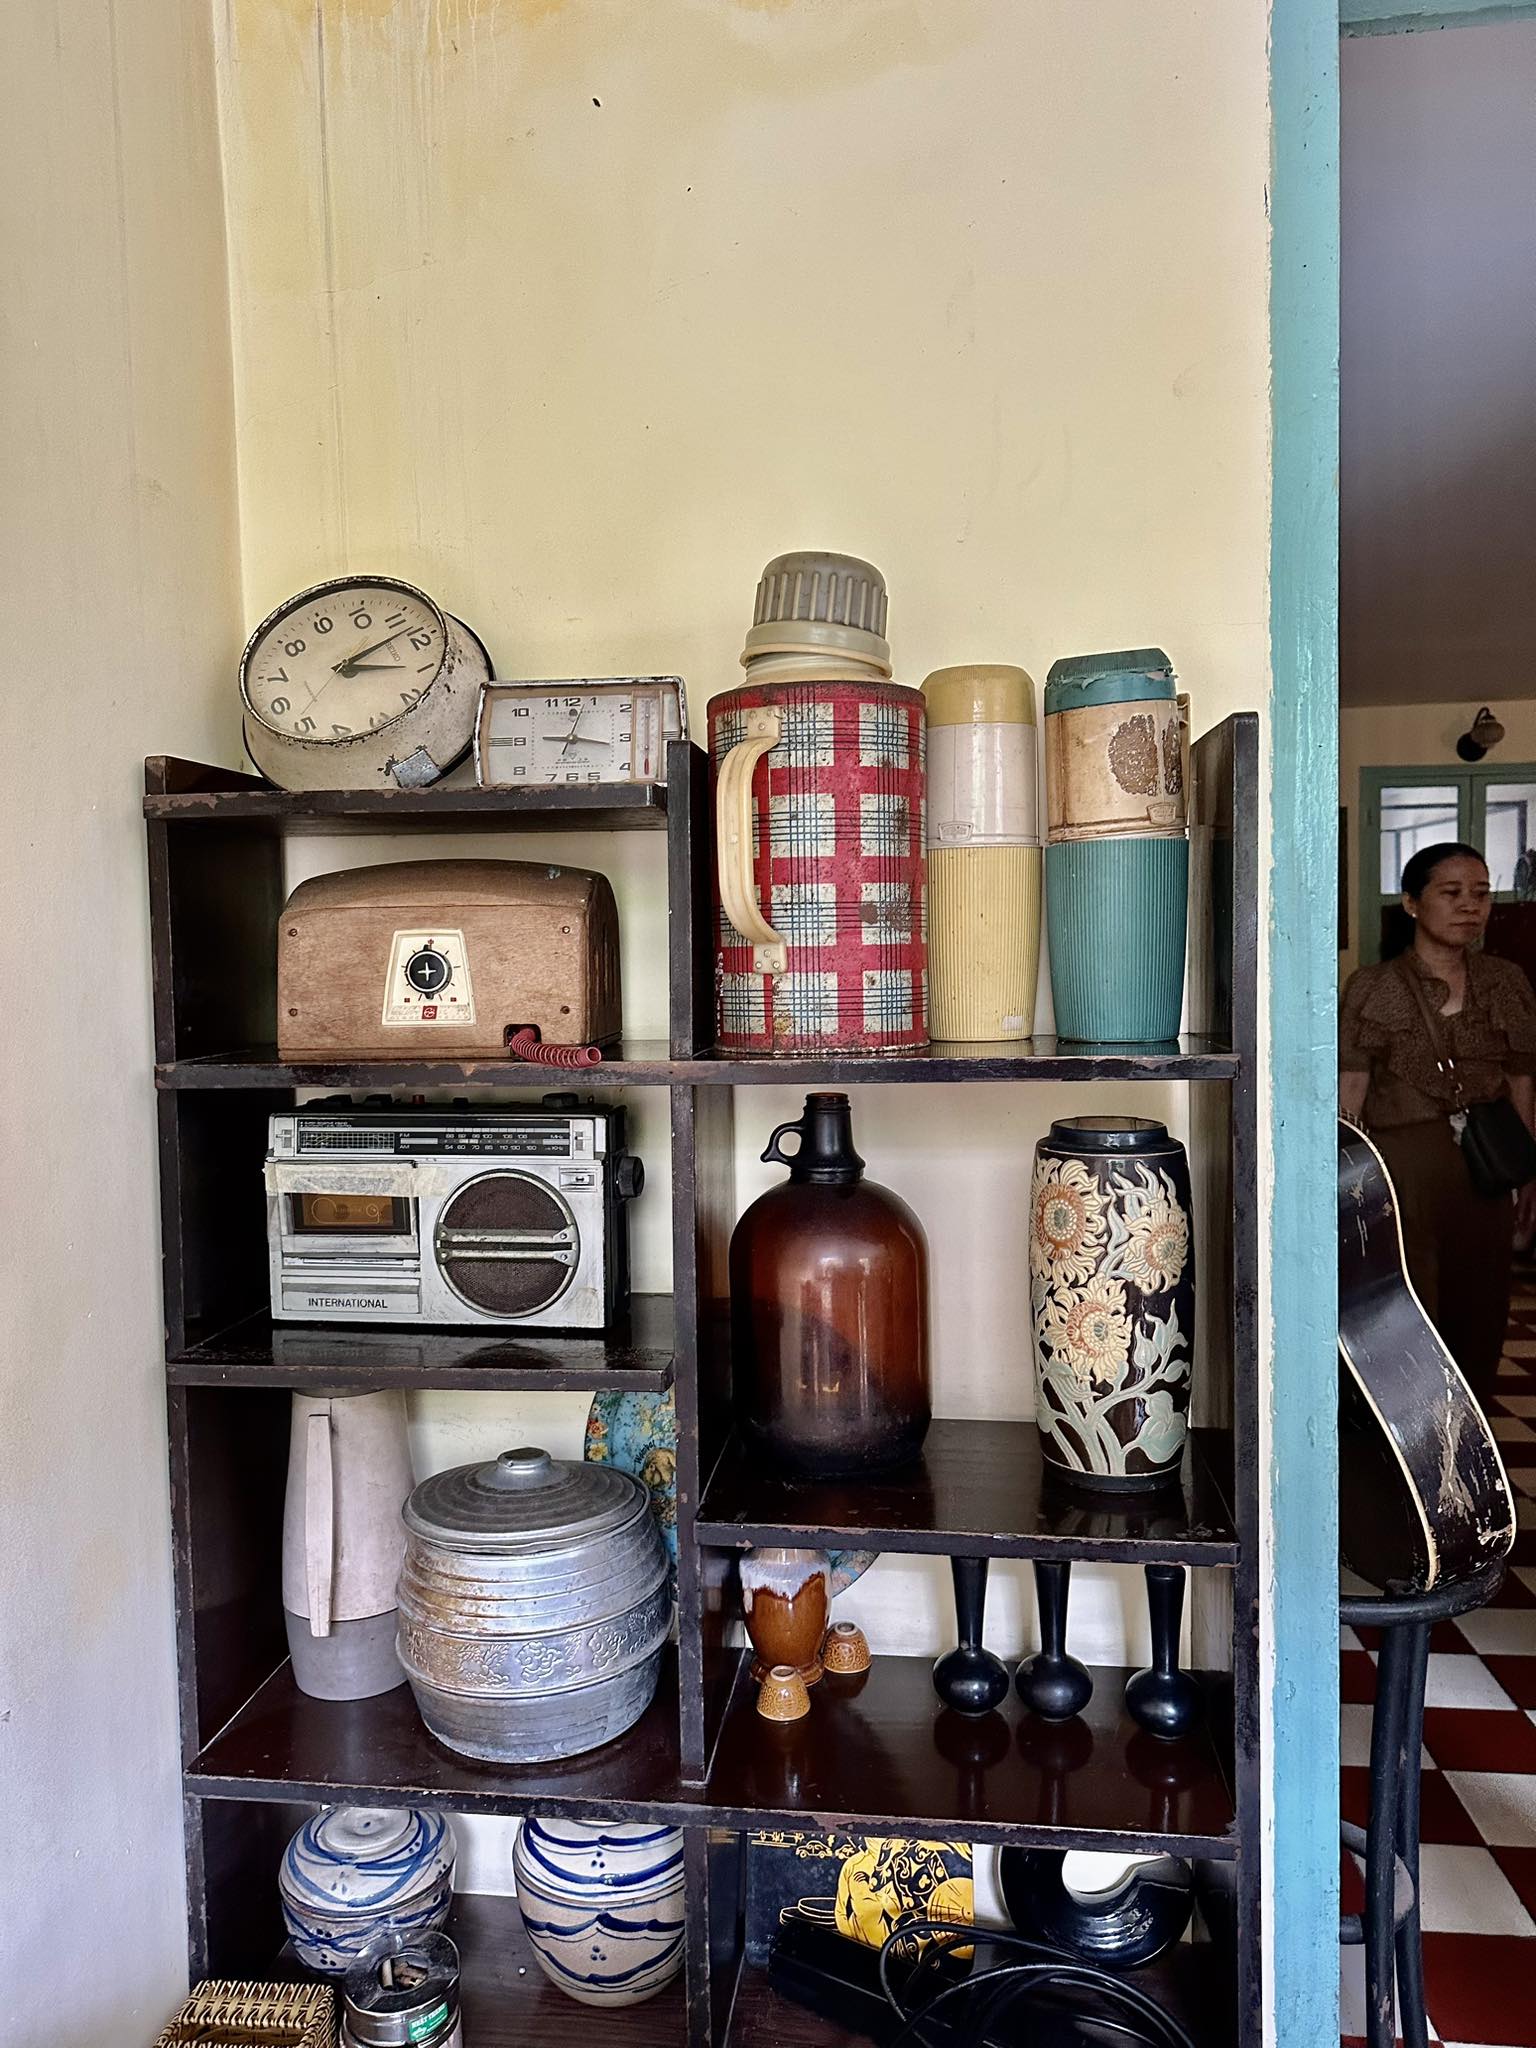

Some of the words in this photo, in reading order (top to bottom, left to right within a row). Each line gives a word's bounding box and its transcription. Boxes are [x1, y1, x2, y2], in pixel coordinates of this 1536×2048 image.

[349, 607, 372, 630] 10
[385, 613, 406, 629] 11
[314, 616, 334, 635] 9
[406, 626, 432, 651] 12
[284, 639, 306, 657] 8
[416, 662, 435, 673] 1
[267, 667, 290, 684] 7
[270, 696, 291, 715] 6
[545, 698, 559, 708] 11
[562, 697, 581, 707] 12
[590, 696, 597, 706] 1
[512, 707, 530, 718] 10
[619, 703, 632, 713] 2
[294, 716, 317, 735] 5
[513, 737, 527, 747] 9
[619, 732, 632, 743] 3
[513, 766, 526, 776] 8
[619, 762, 631, 771] 4
[545, 773, 558, 782] 7
[566, 772, 579, 782] 6
[587, 771, 601, 781] 5
[307, 1297, 388, 1308] INTERNATIONAL
